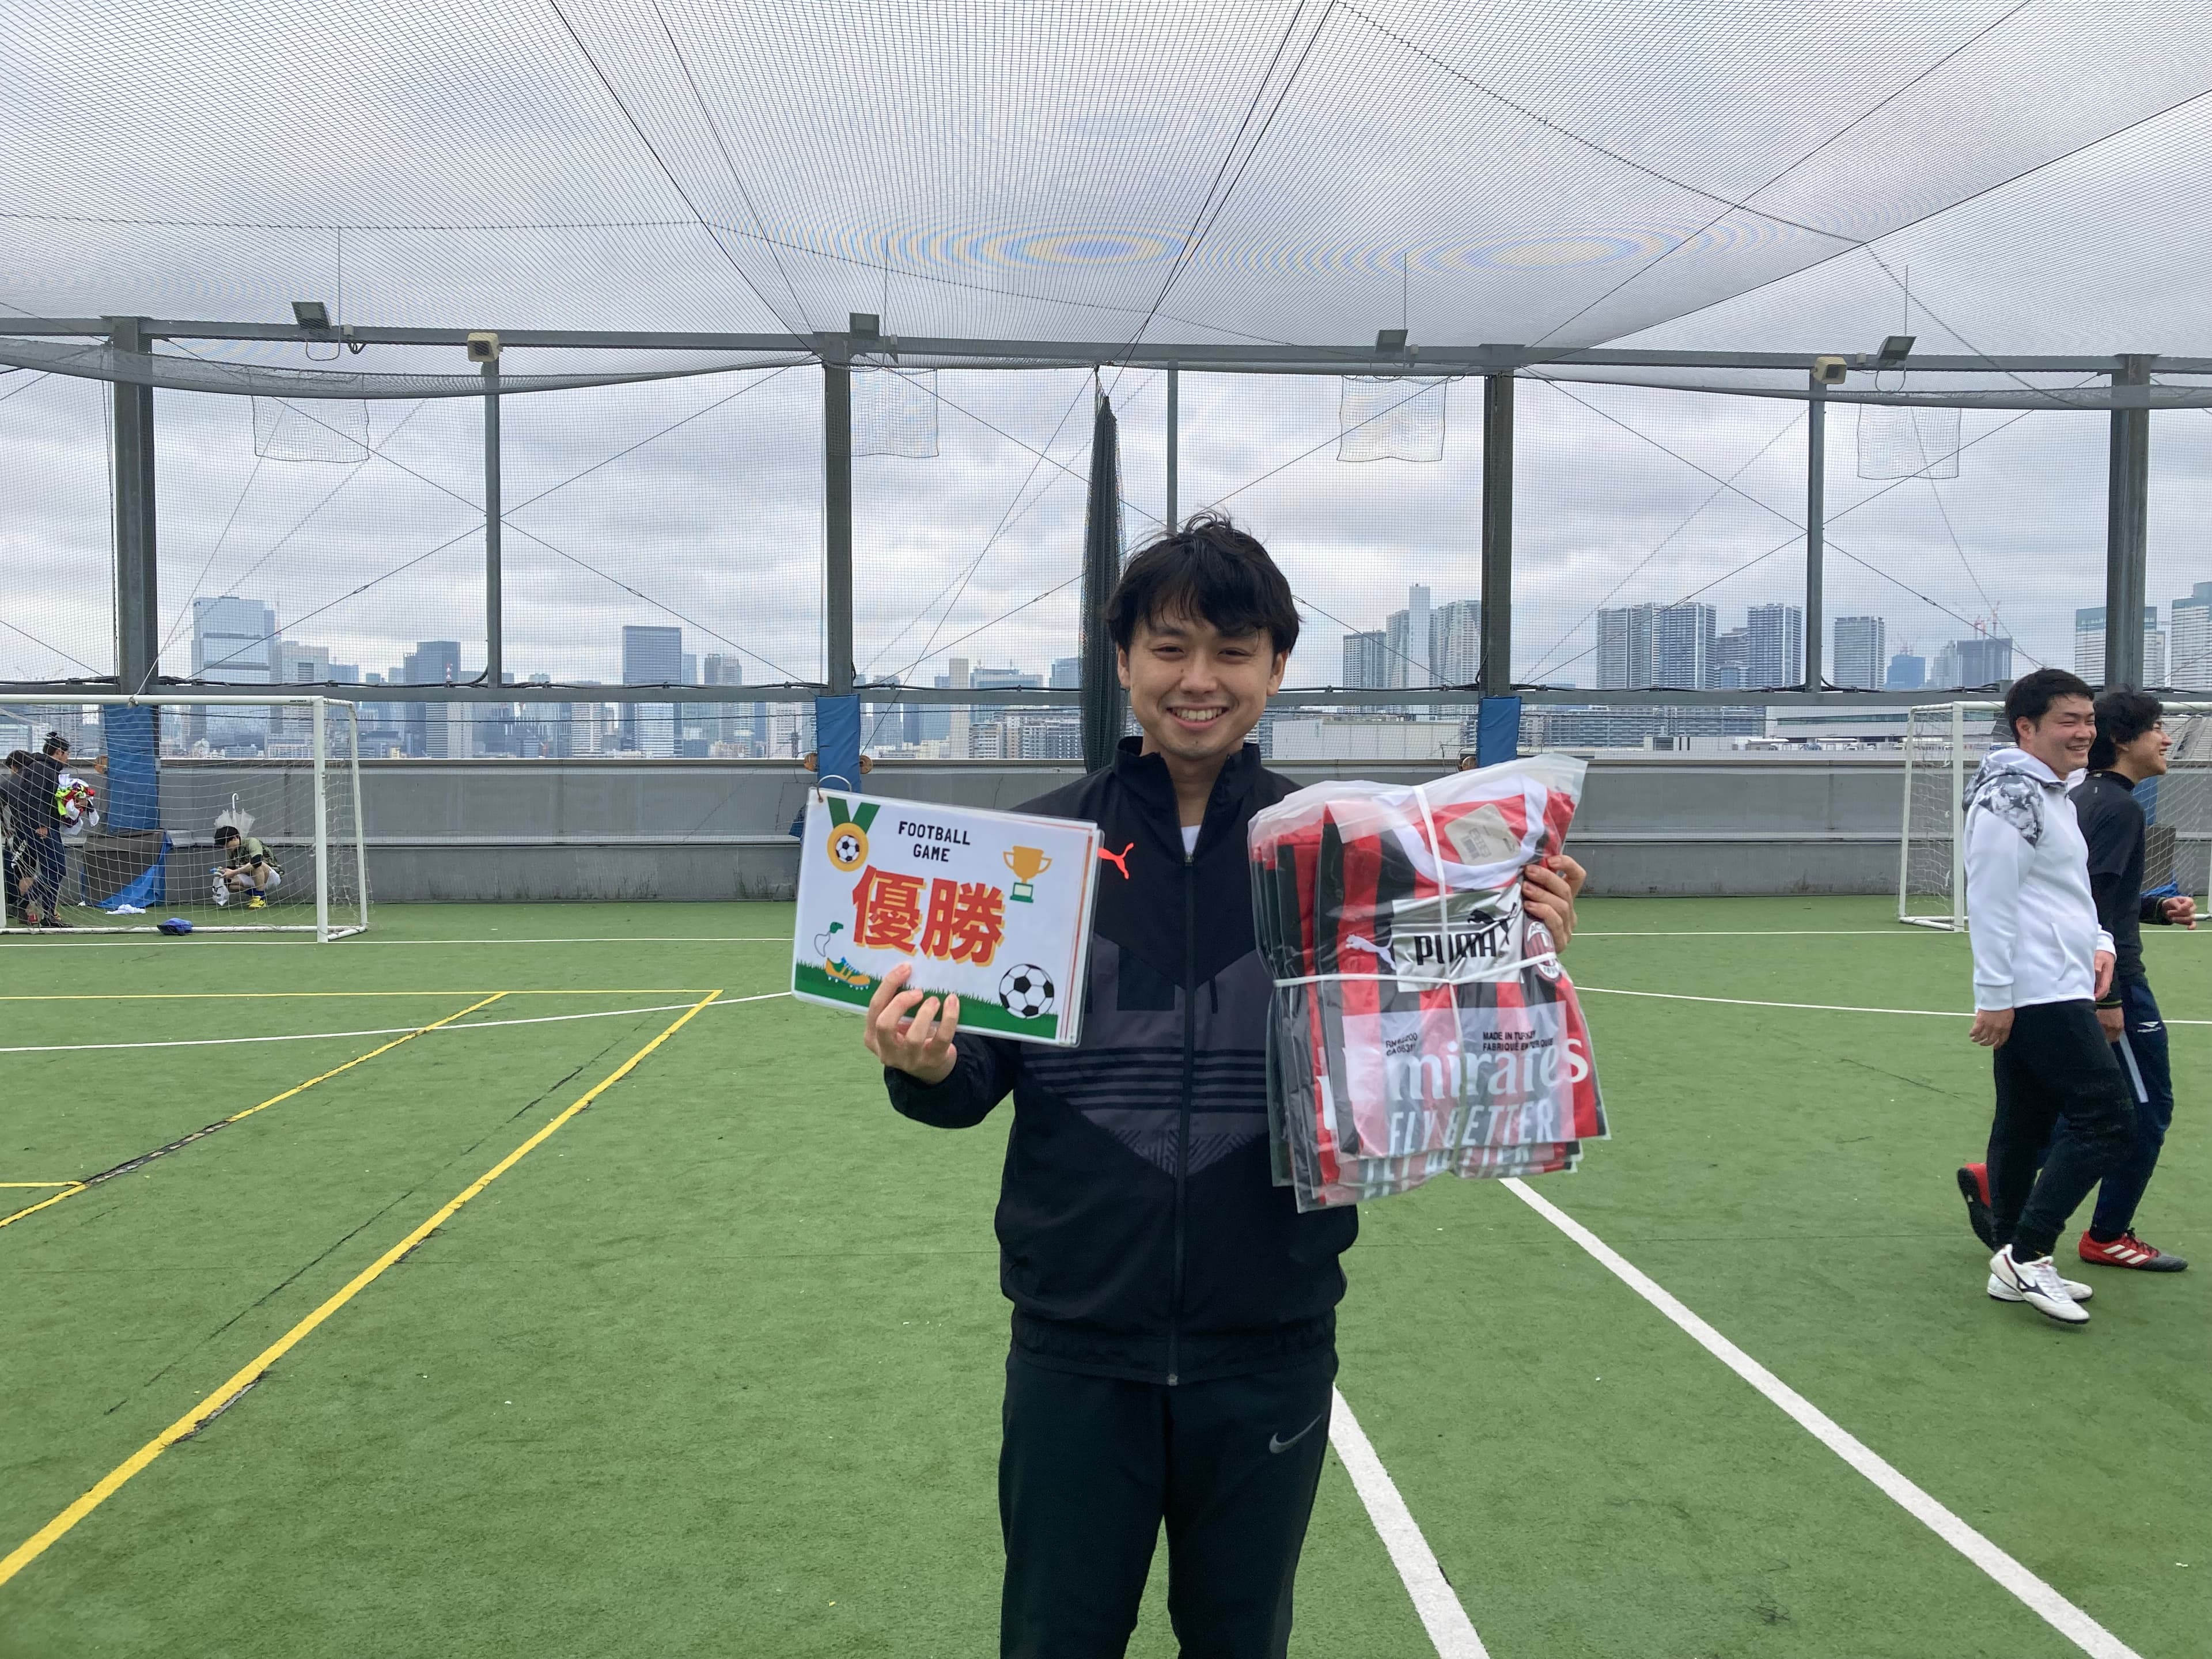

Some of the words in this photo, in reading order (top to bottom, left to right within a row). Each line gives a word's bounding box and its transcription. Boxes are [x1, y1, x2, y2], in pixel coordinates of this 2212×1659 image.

[898, 821, 971, 846] FOOTBALL
[912, 843, 950, 862] GAME
[852, 865, 1005, 967] 優勝
[1414, 927, 1497, 966] PUMA
[1482, 1031, 1503, 1040] MADE
[1505, 1031, 1513, 1040] IN
[1389, 1109, 1438, 1156] FLY
[1441, 1097, 1554, 1149] BETTER
